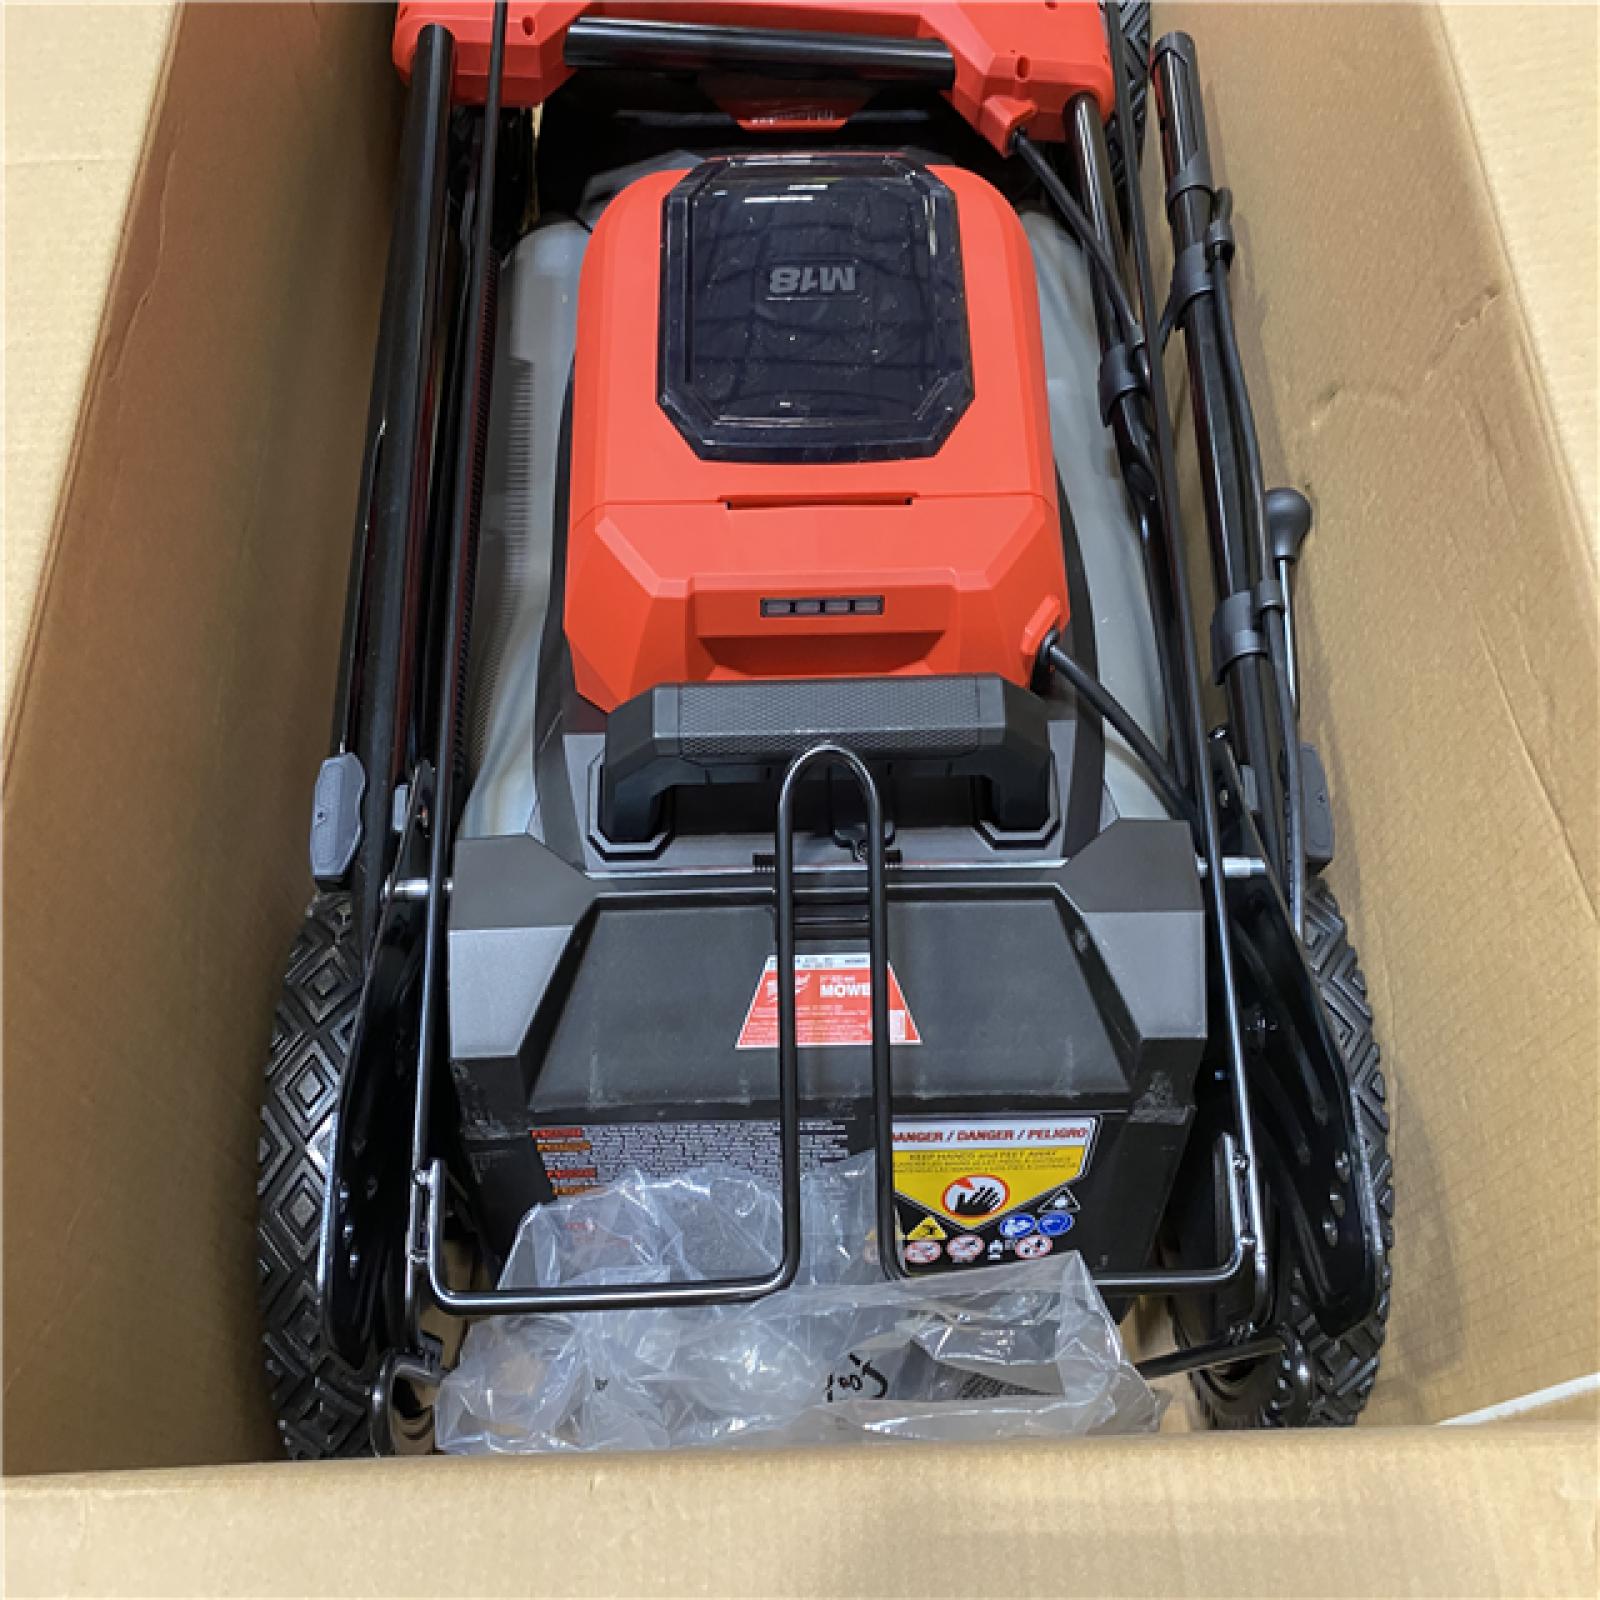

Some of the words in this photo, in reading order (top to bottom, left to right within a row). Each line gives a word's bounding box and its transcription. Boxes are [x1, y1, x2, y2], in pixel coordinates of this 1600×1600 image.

[769, 266, 856, 293] M18
[820, 983, 871, 997] MOWE
[957, 1129, 1014, 1141] DANGER
[1027, 1127, 1088, 1139] PELIGRO
